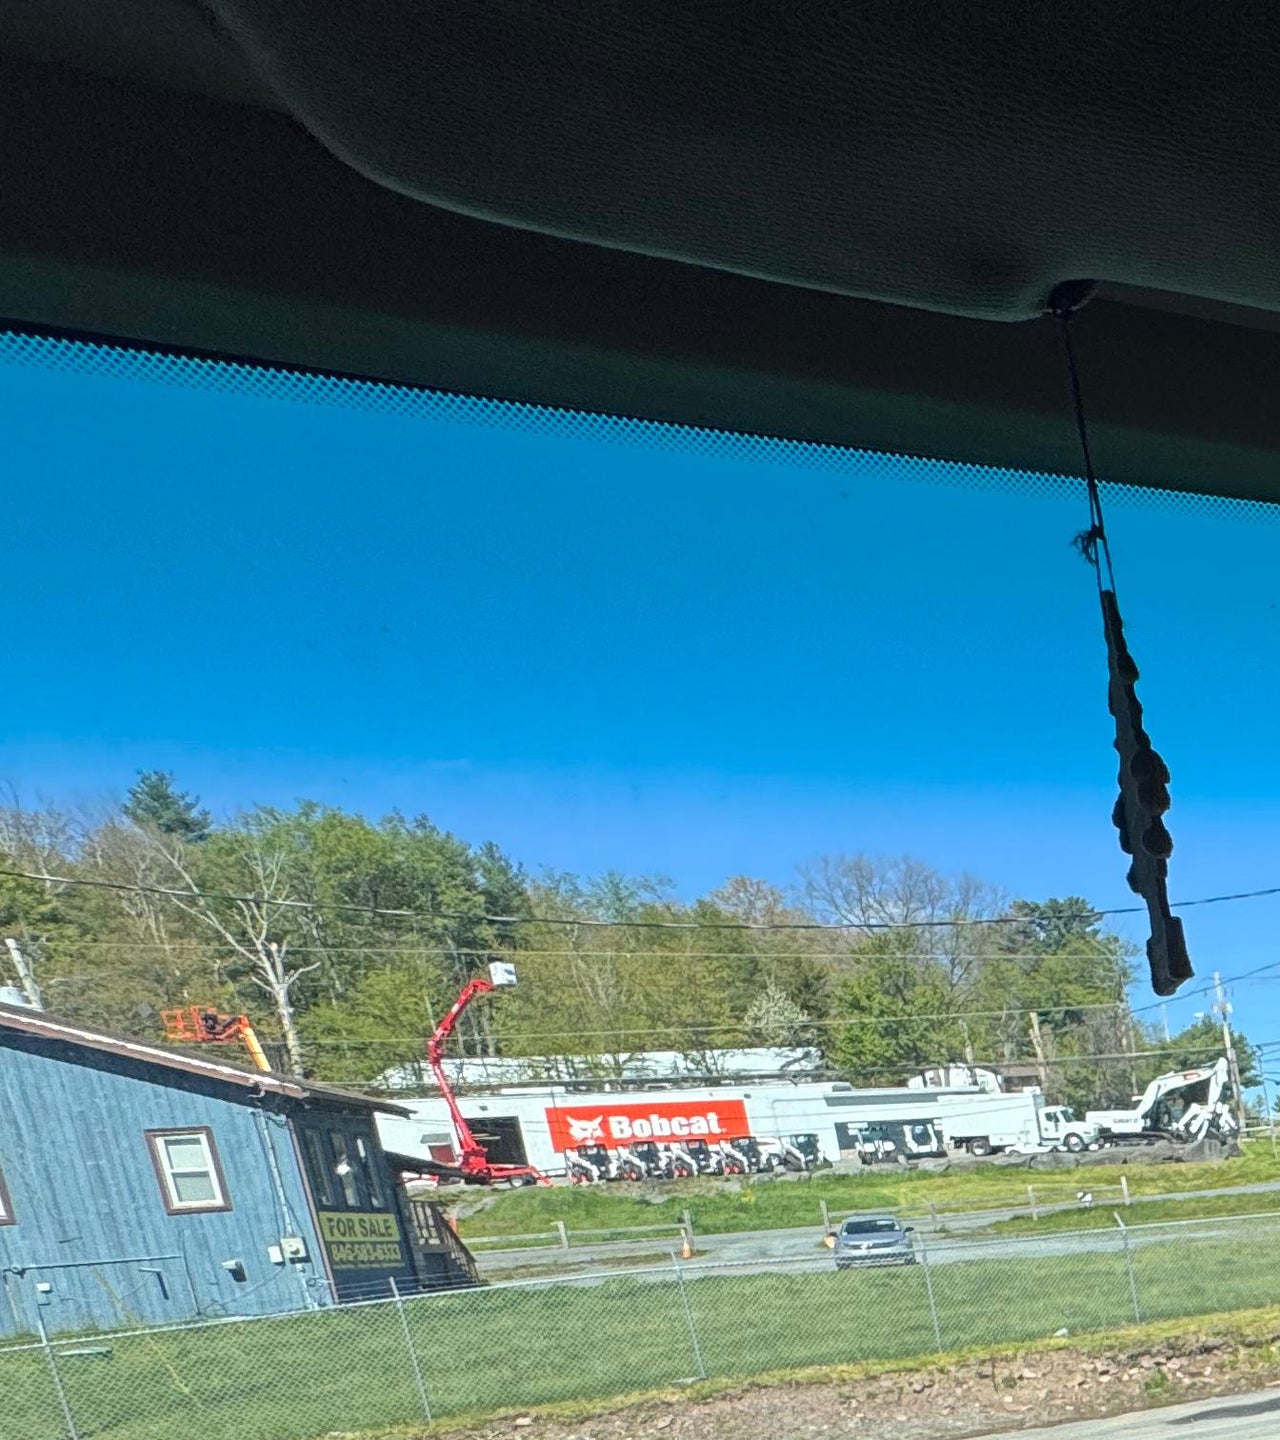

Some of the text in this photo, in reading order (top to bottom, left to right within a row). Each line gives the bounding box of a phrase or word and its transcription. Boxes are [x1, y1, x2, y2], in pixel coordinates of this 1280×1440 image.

[607, 1111, 722, 1139] Bobcat
[326, 1218, 393, 1238] FOR SALE
